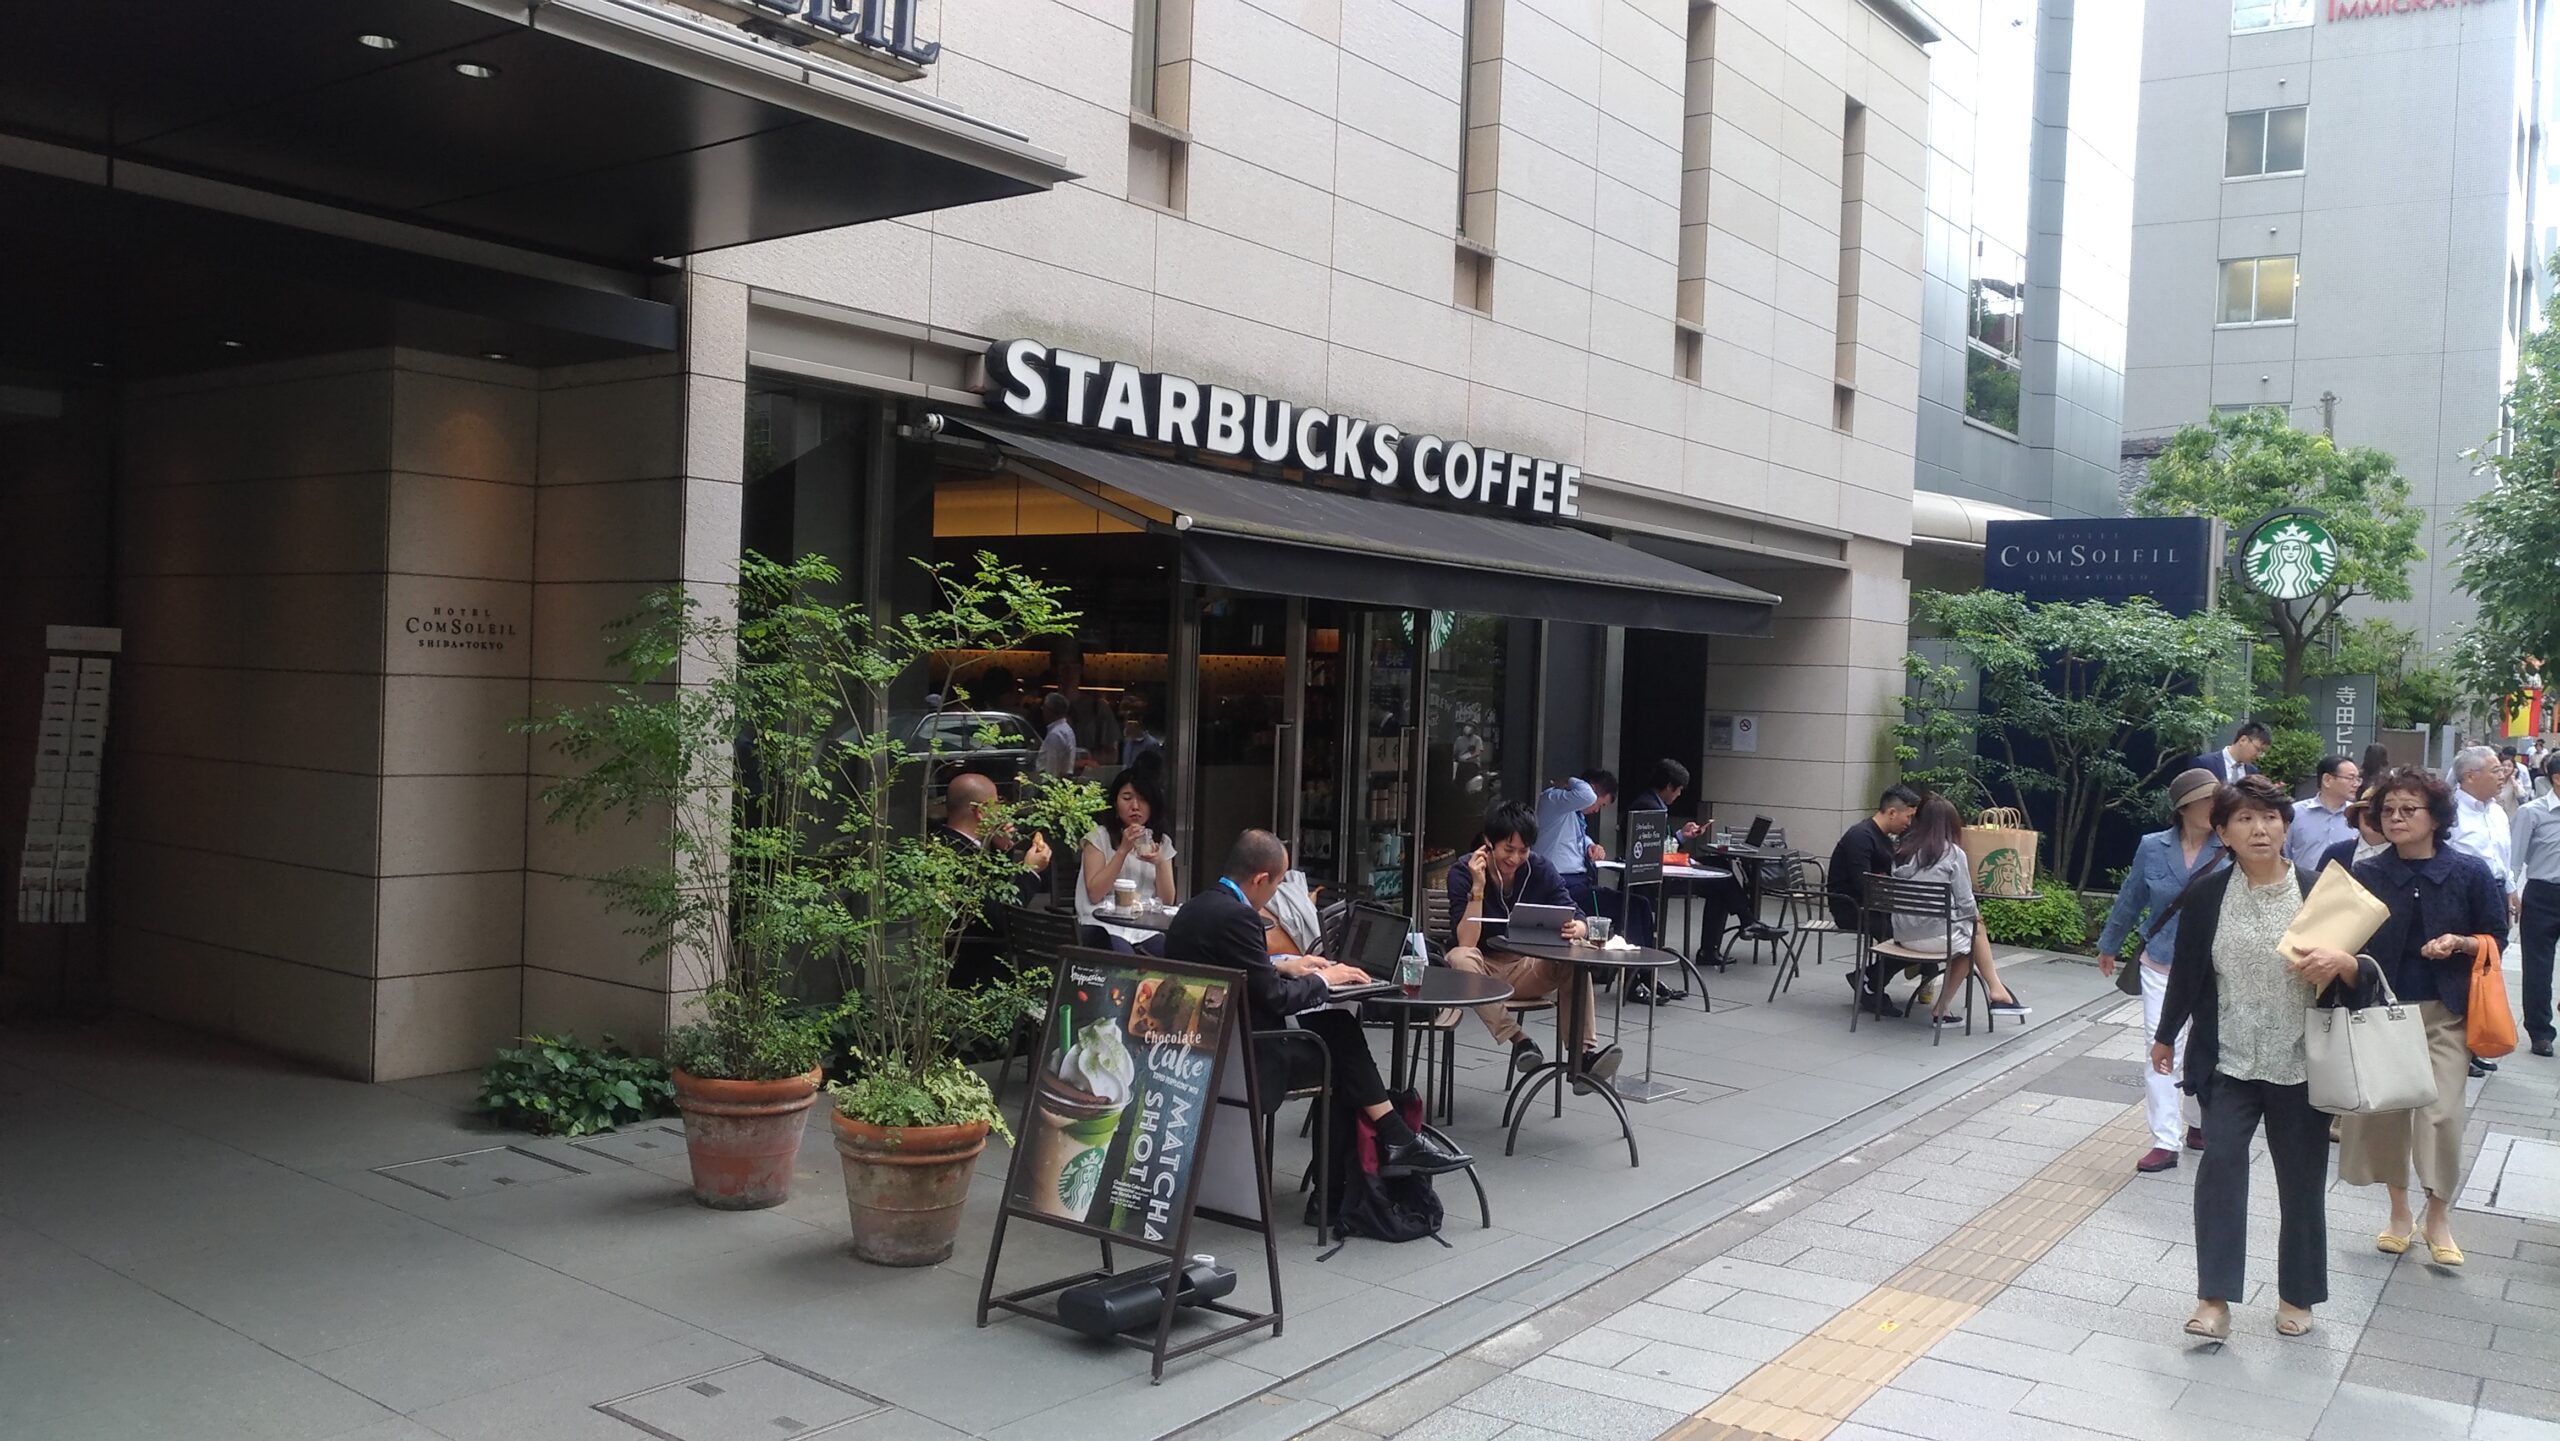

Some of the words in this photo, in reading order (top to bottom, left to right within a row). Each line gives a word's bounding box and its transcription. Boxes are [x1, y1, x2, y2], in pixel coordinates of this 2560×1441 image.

[1002, 337, 1401, 486] STARBUCKS
[1412, 433, 1582, 518] COFFEE
[433, 607, 491, 617] HOTEL
[1144, 1030, 1202, 1044] Chocolate
[1148, 1041, 1204, 1080] Cake
[1129, 1089, 1164, 1182] SHOT
[1143, 1094, 1192, 1242] MATCHA
